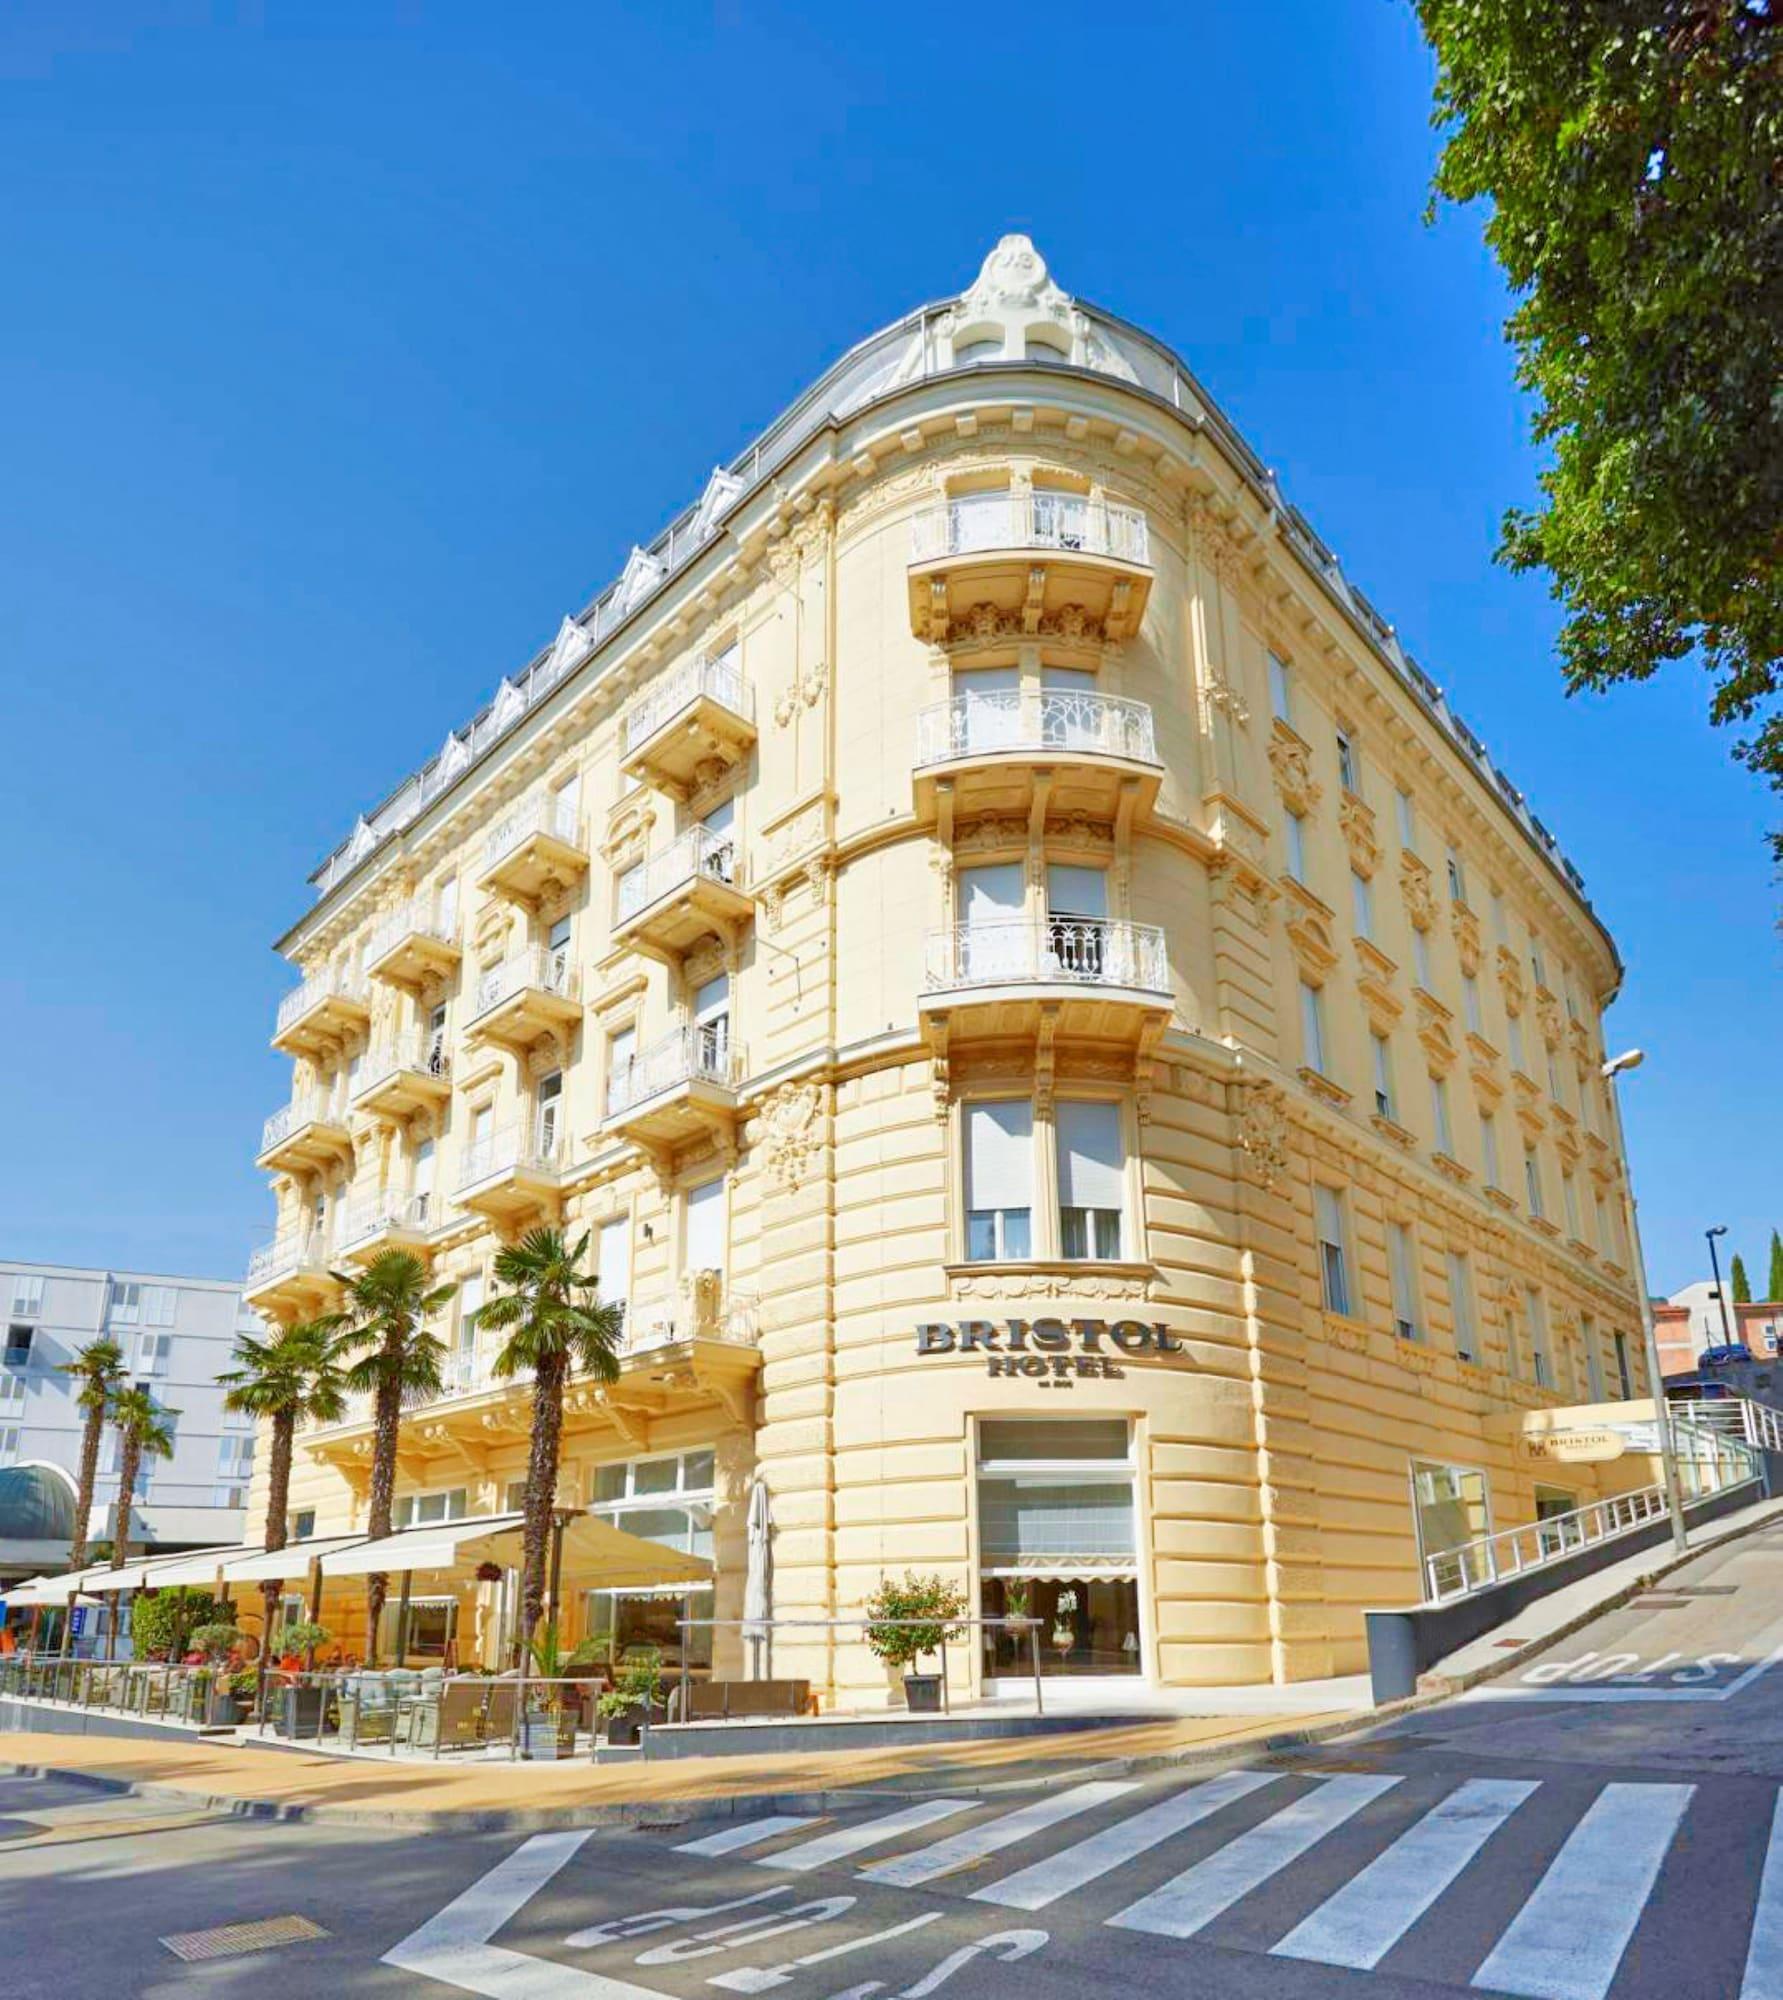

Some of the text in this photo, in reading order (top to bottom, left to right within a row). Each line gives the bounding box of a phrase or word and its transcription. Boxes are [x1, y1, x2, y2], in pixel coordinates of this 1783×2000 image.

[915, 1317, 1183, 1353] BRISTOL
[988, 1355, 1124, 1379] HOTEL
[1519, 1652, 1742, 1683] STOP
